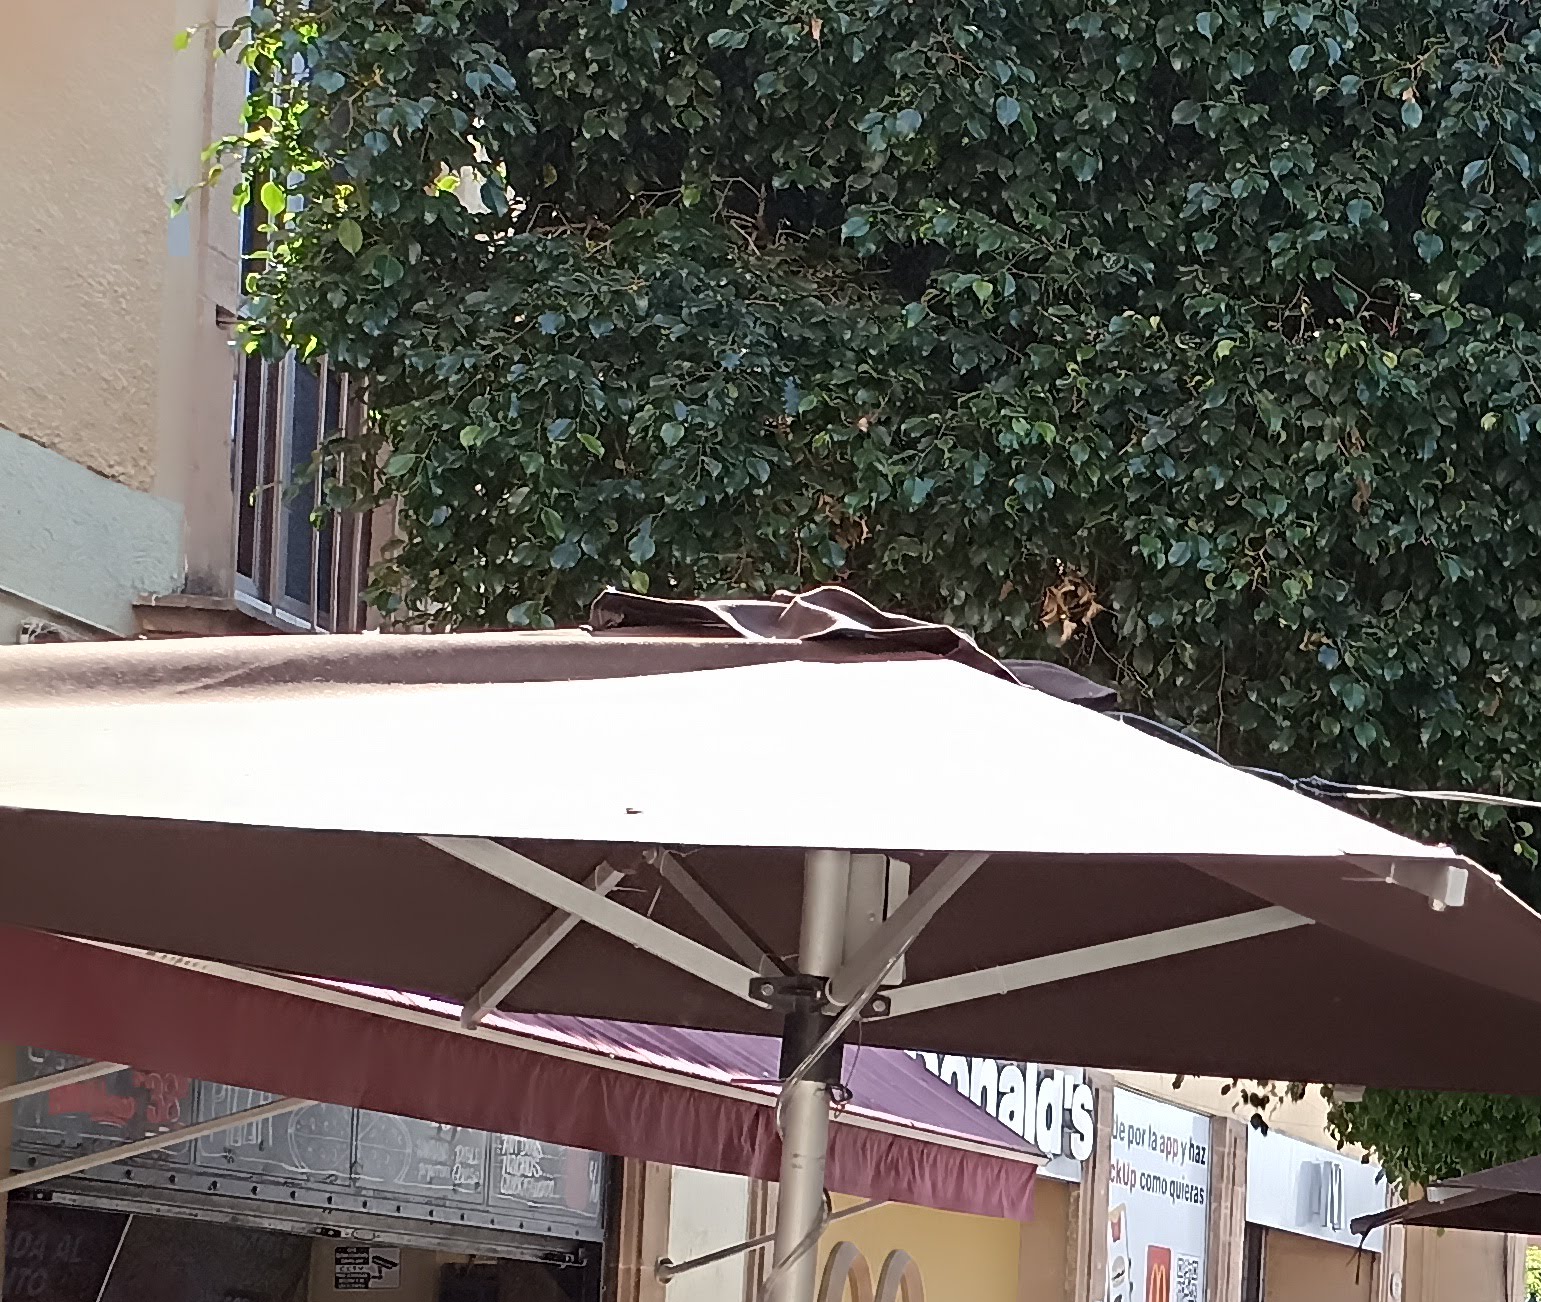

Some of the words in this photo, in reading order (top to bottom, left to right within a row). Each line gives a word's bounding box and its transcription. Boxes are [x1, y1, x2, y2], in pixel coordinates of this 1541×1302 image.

[904, 1050, 1095, 1161] onald's
[1113, 1113, 1125, 1141] de
[1127, 1124, 1146, 1150] por
[1148, 1124, 1158, 1151] la
[1159, 1134, 1179, 1163] app
[1180, 1141, 1188, 1166] y
[1188, 1135, 1207, 1165] haz
[1110, 1158, 1137, 1194] ckUp
[1139, 1172, 1168, 1195] como
[1169, 1175, 1205, 1205] quieras
